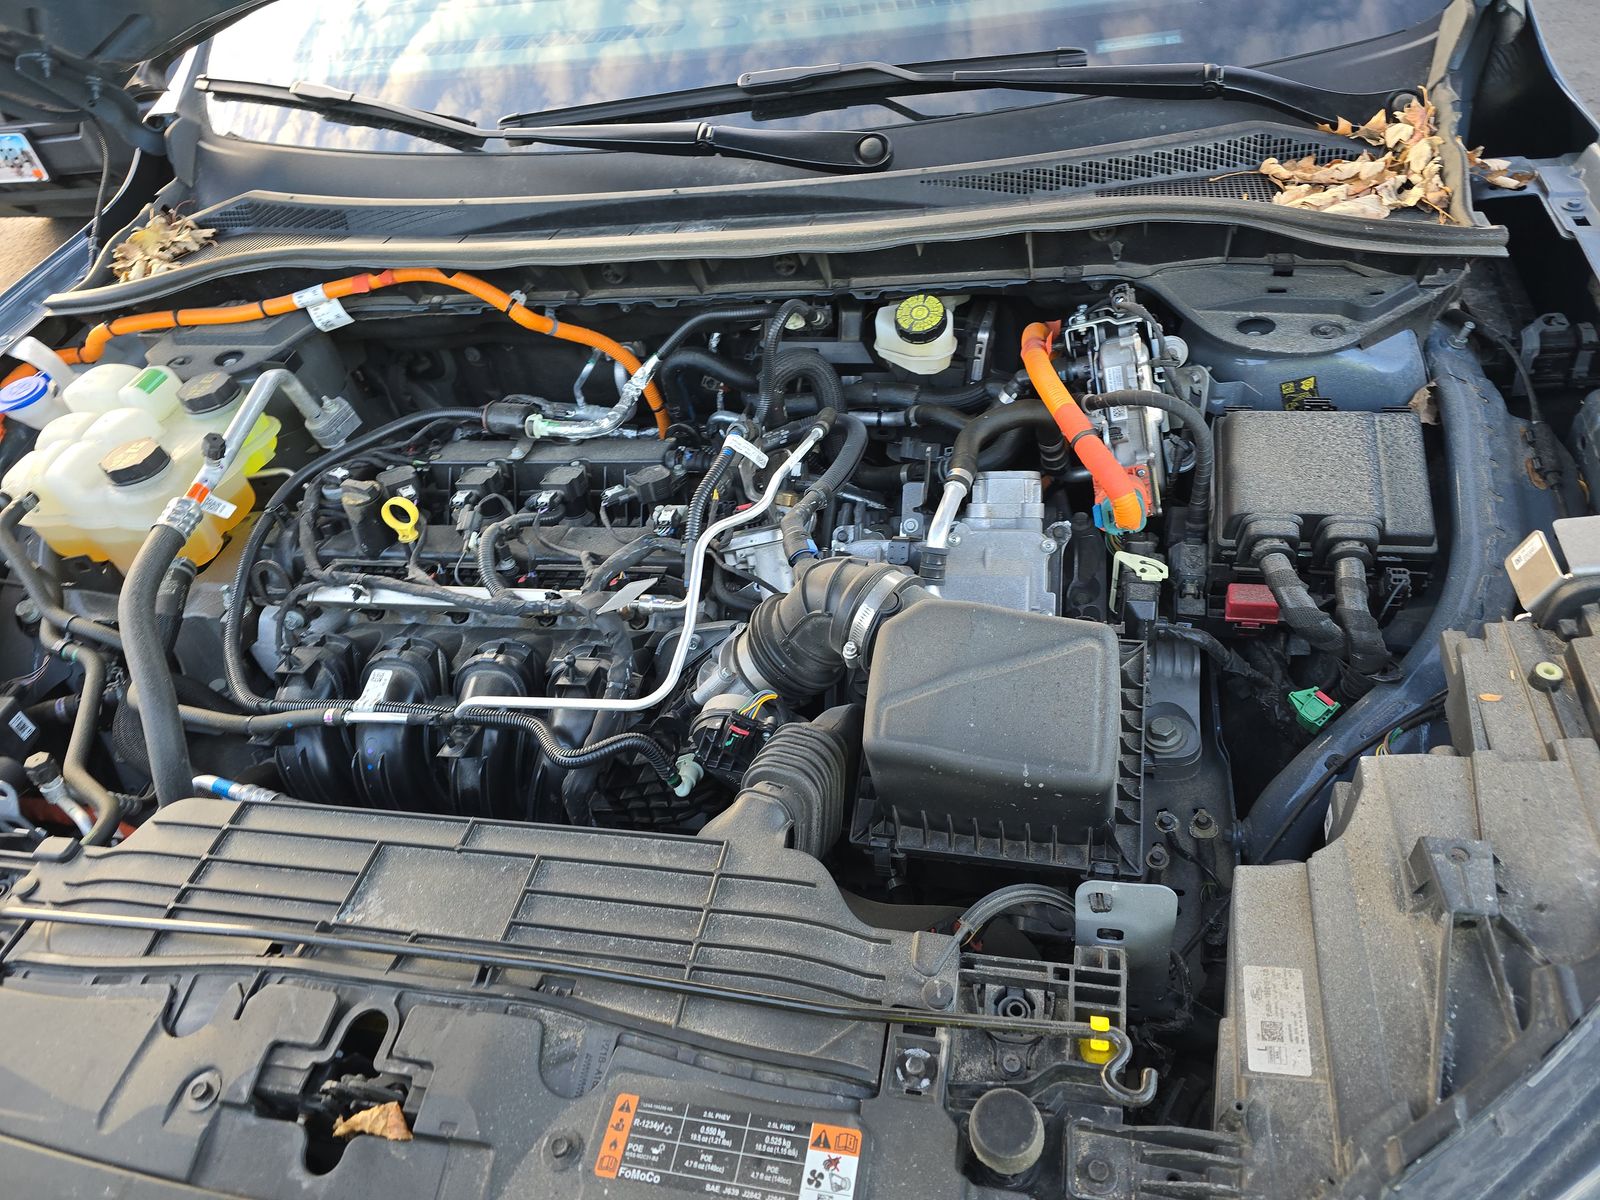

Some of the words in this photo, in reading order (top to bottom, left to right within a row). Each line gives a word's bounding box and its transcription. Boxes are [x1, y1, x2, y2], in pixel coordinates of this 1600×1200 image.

[715, 1112, 731, 1121] PHEV
[633, 1118, 665, 1132] R-1234yf
[779, 1123, 796, 1132] PHEV
[700, 1125, 717, 1136] 0.550
[717, 1128, 726, 1139] kg
[764, 1135, 782, 1146] 0.525
[782, 1137, 792, 1149] kg
[627, 1143, 644, 1153] POE
[700, 1153, 713, 1163] POE
[766, 1165, 780, 1175] POE
[618, 1167, 660, 1184] FoMoCo
[704, 1183, 721, 1193] SAE
